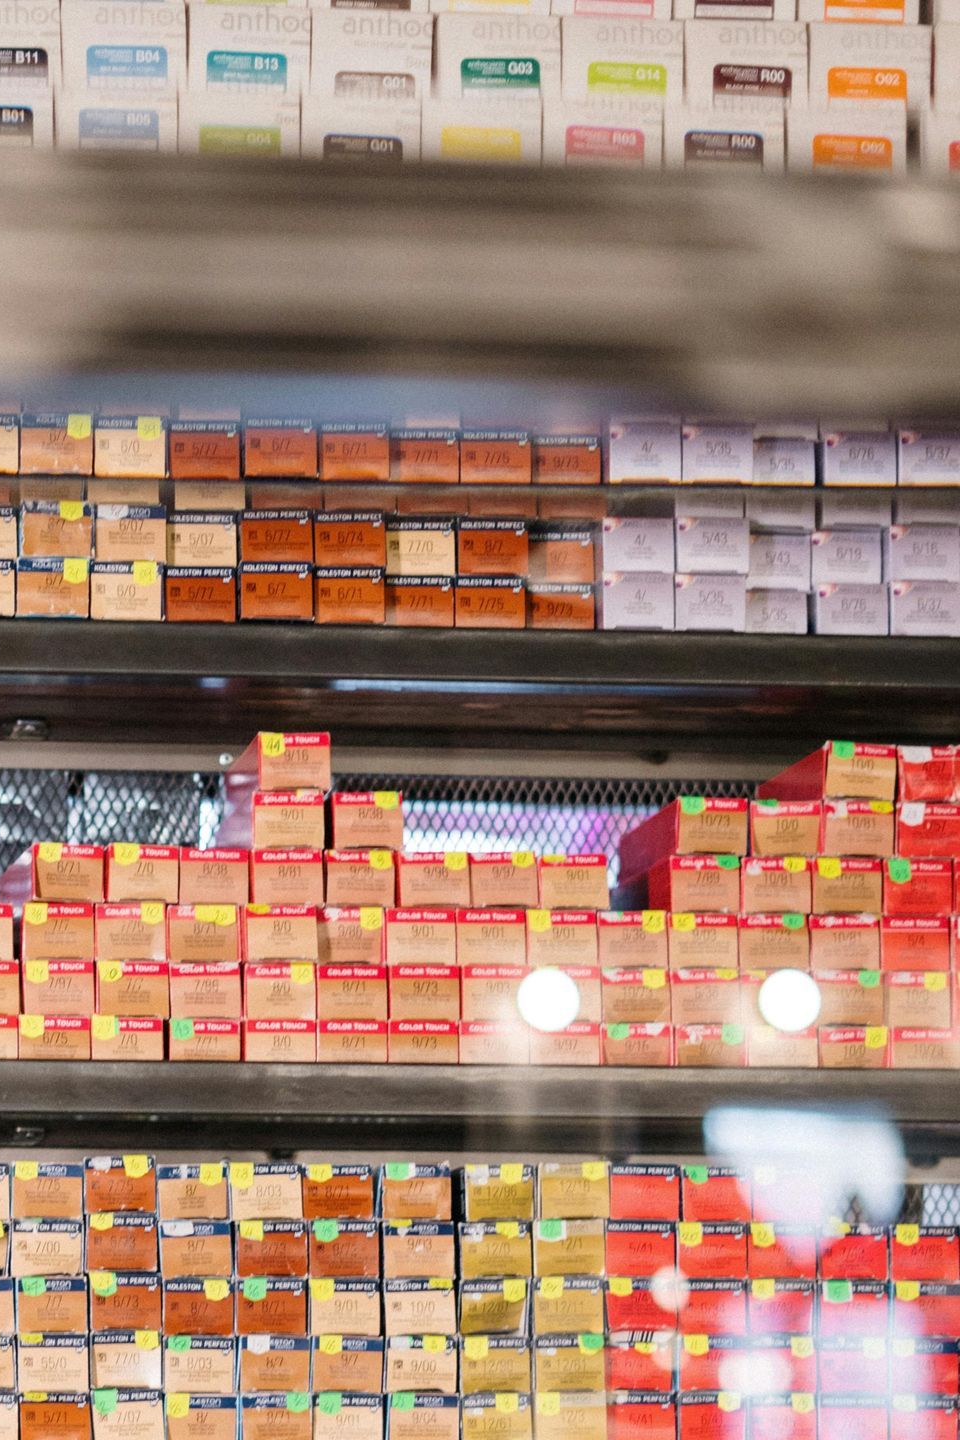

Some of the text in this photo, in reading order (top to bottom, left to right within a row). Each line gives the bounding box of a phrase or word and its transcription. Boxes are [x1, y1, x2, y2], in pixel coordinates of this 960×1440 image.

[15, 51, 38, 63] B11
[136, 50, 160, 62] B04
[254, 57, 278, 70] B13
[509, 62, 533, 74] G03
[636, 69, 660, 81] G14
[761, 70, 785, 82] R00
[383, 77, 406, 88] G01
[2, 110, 24, 122] B01
[613, 133, 636, 145] R03
[731, 136, 755, 148] R00
[370, 140, 394, 152] G01
[192, 442, 217, 454] 5/77
[641, 442, 653, 454] 4/
[414, 450, 438, 462] 7/71
[120, 520, 144, 531] 6/07
[189, 534, 213, 546] 5/07
[634, 534, 646, 546] 4/
[408, 540, 433, 553] 77/0
[117, 585, 136, 597] 6/0
[189, 588, 214, 599] 5/77
[268, 583, 287, 595] 6/7
[338, 588, 364, 600] 6/71
[408, 596, 434, 608] 7/71
[478, 597, 504, 610] 7/75
[295, 736, 319, 744] TOUCH
[284, 749, 309, 762] 9/16
[281, 808, 304, 820] 9/01
[358, 808, 382, 820] 8/38
[699, 816, 730, 827] 10/73
[776, 819, 799, 832] 10/0
[263, 852, 313, 861] COLOR TOUCH
[136, 864, 154, 875] 7/0
[397, 912, 447, 921] COLOR TOUCH
[466, 913, 516, 921] COLOR TOUCH
[273, 921, 291, 932] 8/0
[411, 925, 435, 938] 9/01
[481, 927, 505, 939] 9/01
[341, 981, 366, 994] 8/71
[413, 981, 438, 994] 9/73
[255, 1022, 306, 1030] COLOR TOUCH
[398, 1022, 449, 1031] COLOR TOUCH
[43, 1033, 68, 1044] 6/75
[120, 1035, 137, 1046] 7/0
[273, 1036, 291, 1047] 8/0
[341, 1037, 366, 1049] 8/71
[412, 1037, 437, 1049] 9/73
[613, 1167, 675, 1176] KOLESTON PERFECT
[256, 1185, 281, 1197] 8/03
[608, 1224, 670, 1233] KOLESTON PERFECT
[35, 1242, 60, 1254] 7/00
[335, 1300, 358, 1312] 9/01
[412, 1301, 435, 1313] 10/0
[114, 1352, 140, 1364] 77/0
[187, 1357, 212, 1369] 8/03
[342, 1353, 357, 1366] 9/7
[411, 1360, 436, 1372] 9/00
